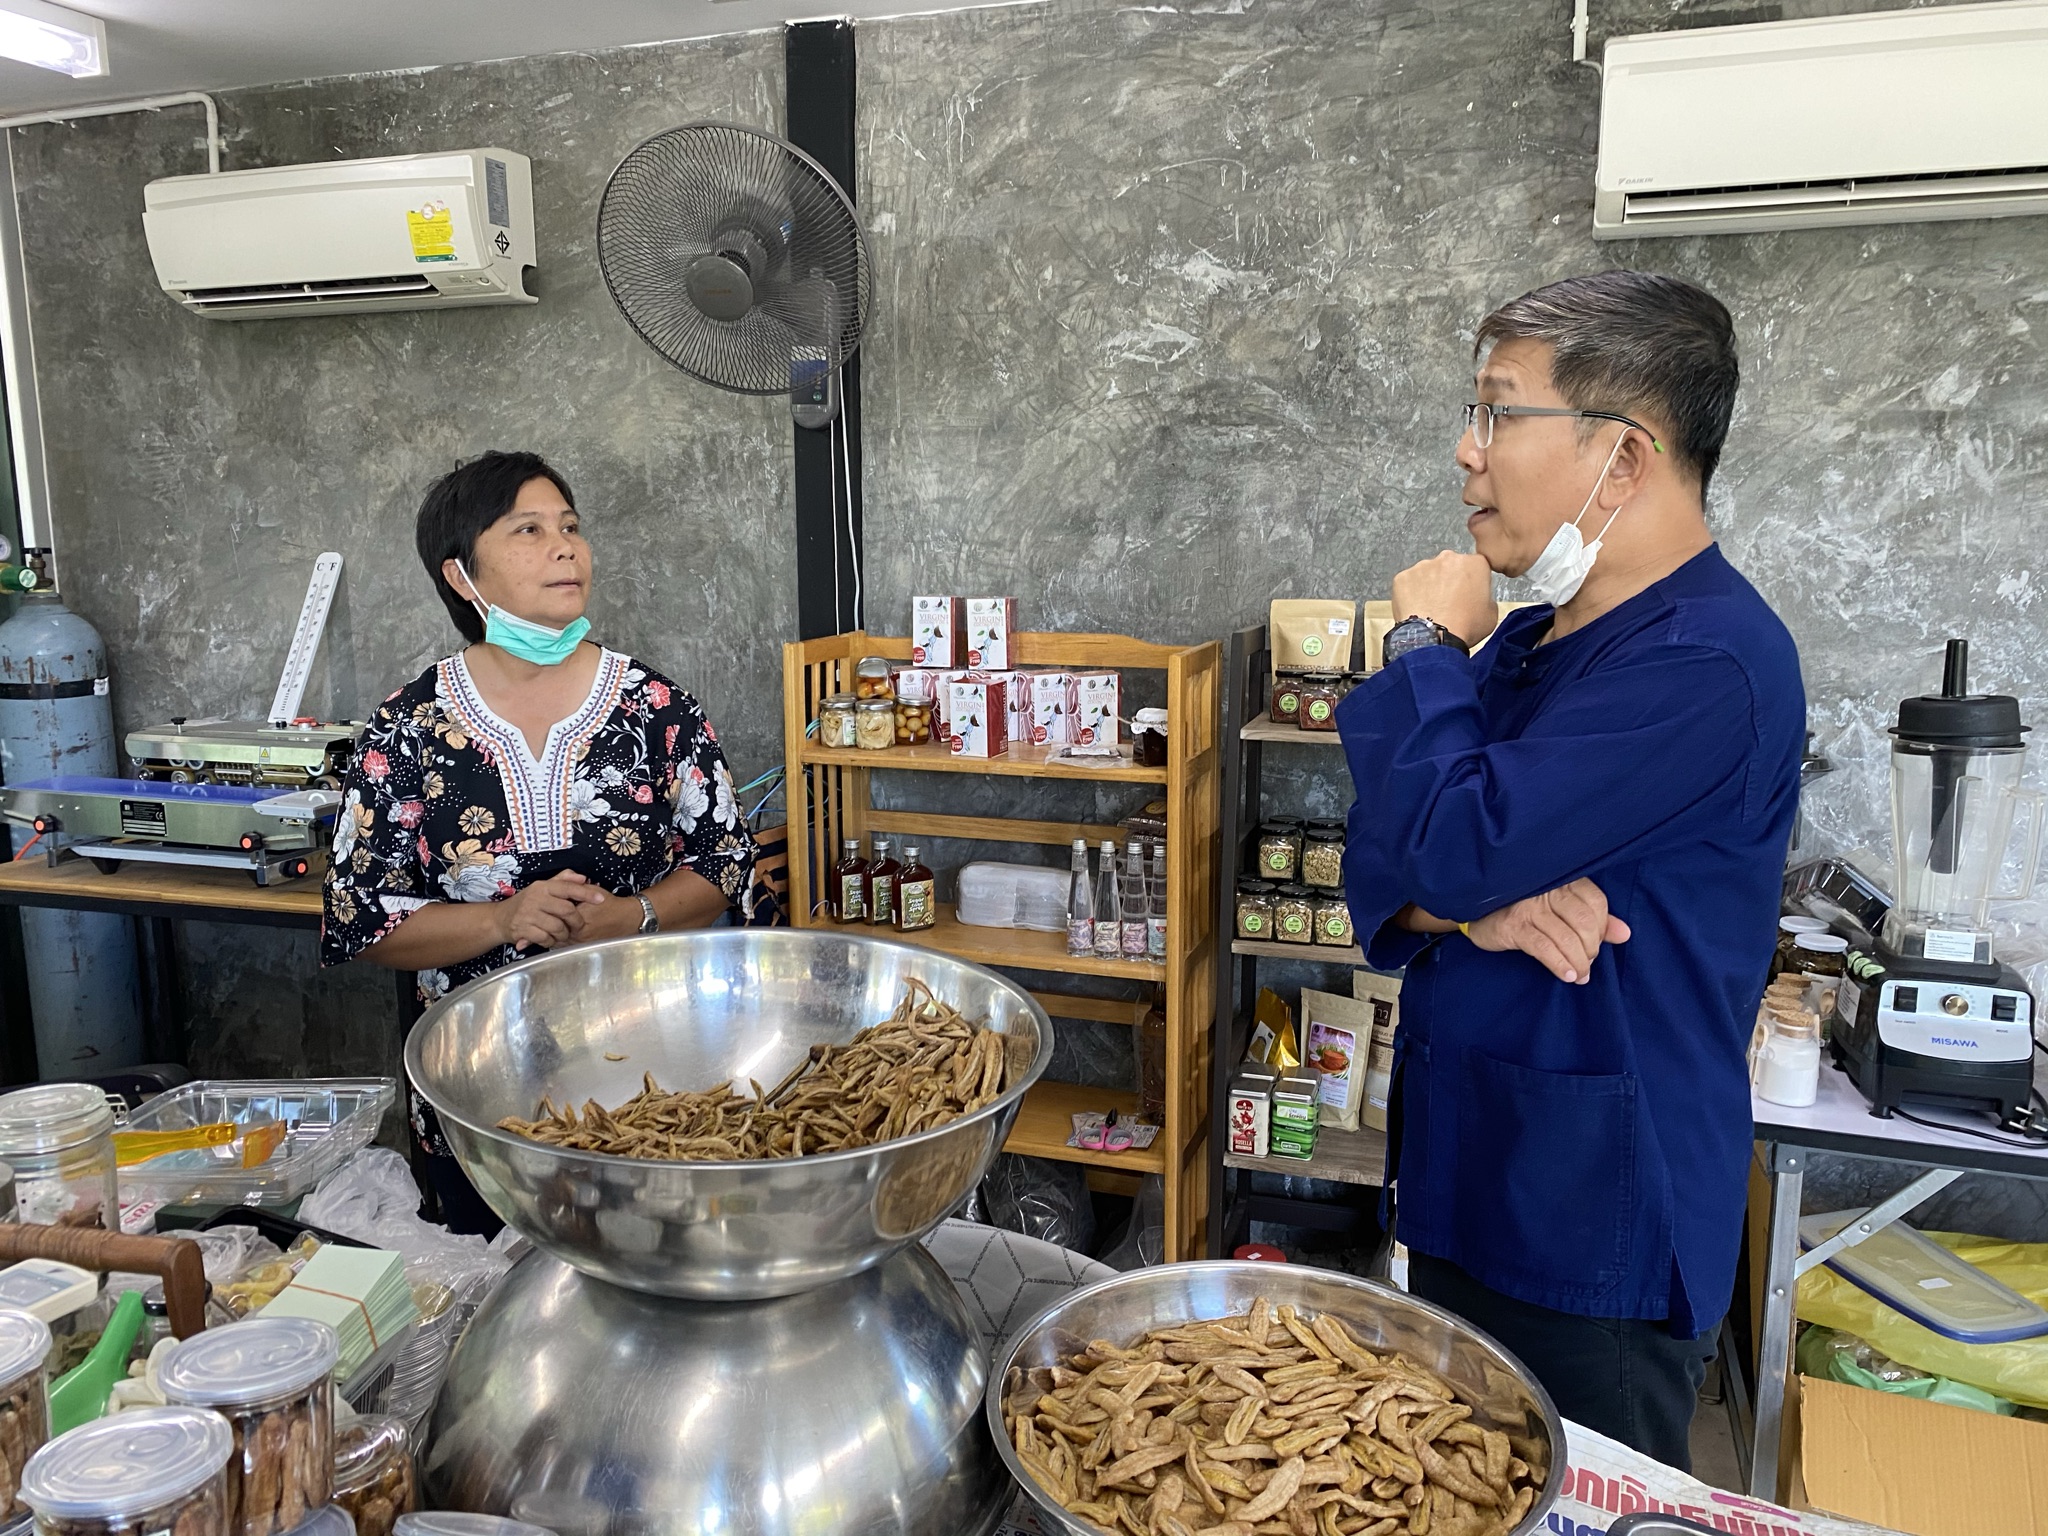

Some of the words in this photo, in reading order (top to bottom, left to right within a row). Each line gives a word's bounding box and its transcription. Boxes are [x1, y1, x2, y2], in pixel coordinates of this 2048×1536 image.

[920, 613, 946, 621] VIRGIN
[1041, 690, 1065, 699] VIRGIN
[1088, 692, 1113, 700] VIRGIN
[956, 701, 981, 709] VIRGIN
[1931, 1037, 1979, 1048] MISAWA
